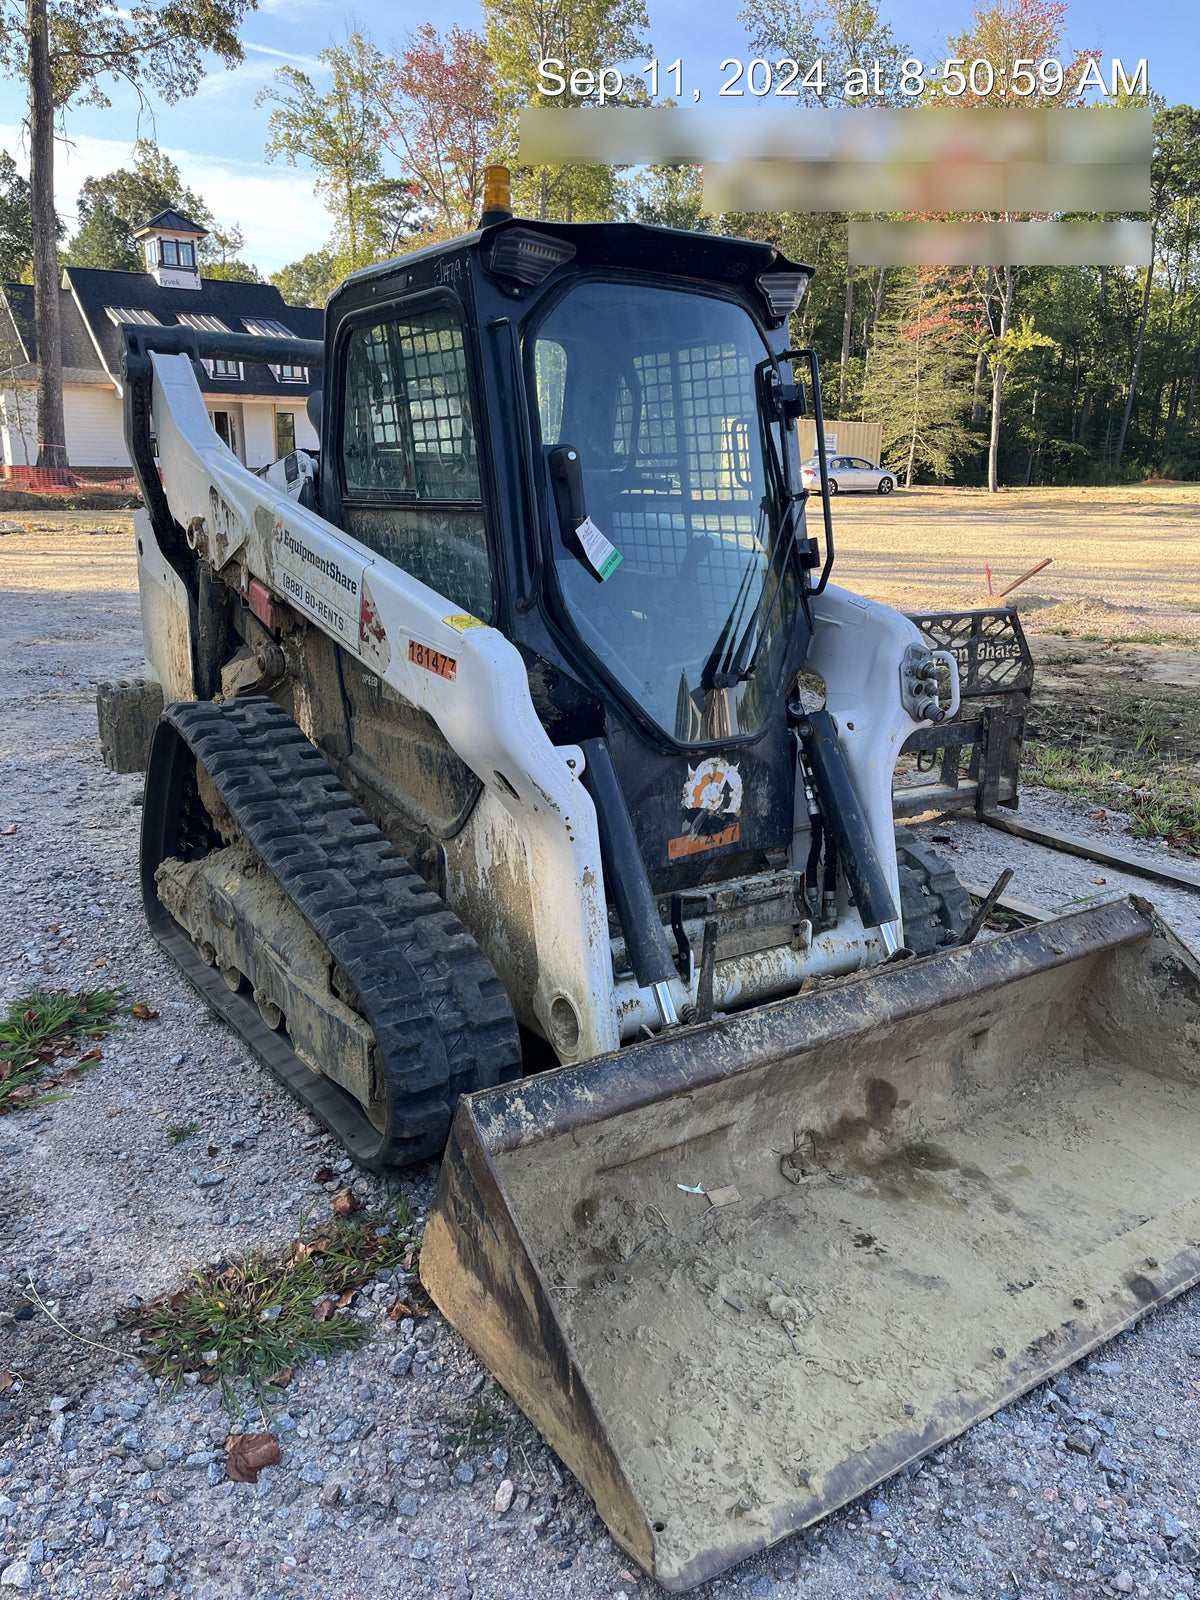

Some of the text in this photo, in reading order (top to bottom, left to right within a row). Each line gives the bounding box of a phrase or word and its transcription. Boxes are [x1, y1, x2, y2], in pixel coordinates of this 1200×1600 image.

[160, 278, 181, 287] Tyvek
[284, 529, 358, 596] EquipmentShare
[282, 572, 303, 600] (888)
[409, 640, 457, 681] 181477
